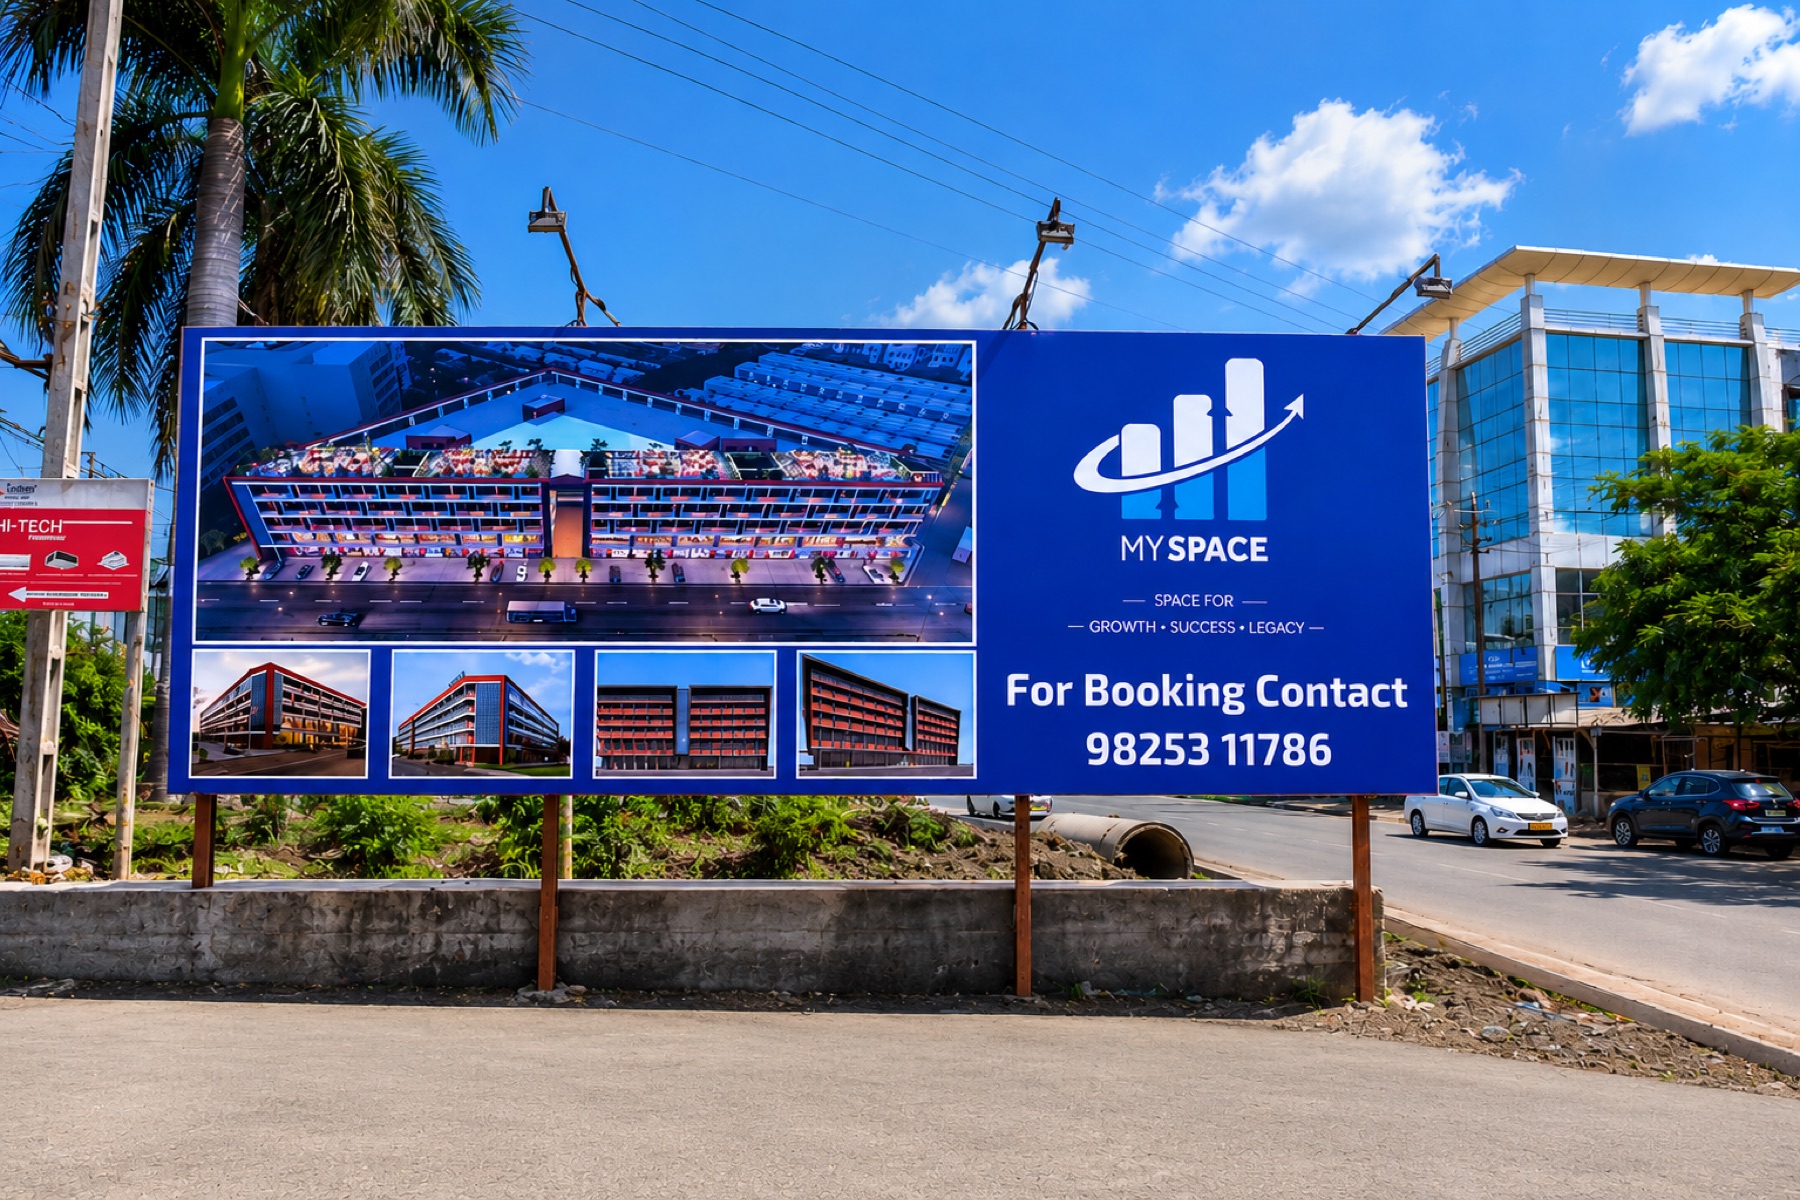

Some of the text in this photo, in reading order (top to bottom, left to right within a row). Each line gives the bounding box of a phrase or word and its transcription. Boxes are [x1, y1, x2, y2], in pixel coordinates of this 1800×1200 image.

[1154, 594, 1234, 608] SPACE FOR
[1089, 620, 1305, 634] GROWTH SUCCESS LEGACY
[1006, 673, 1408, 716] For Booking Contact
[1086, 731, 1332, 767] 98253 11786
